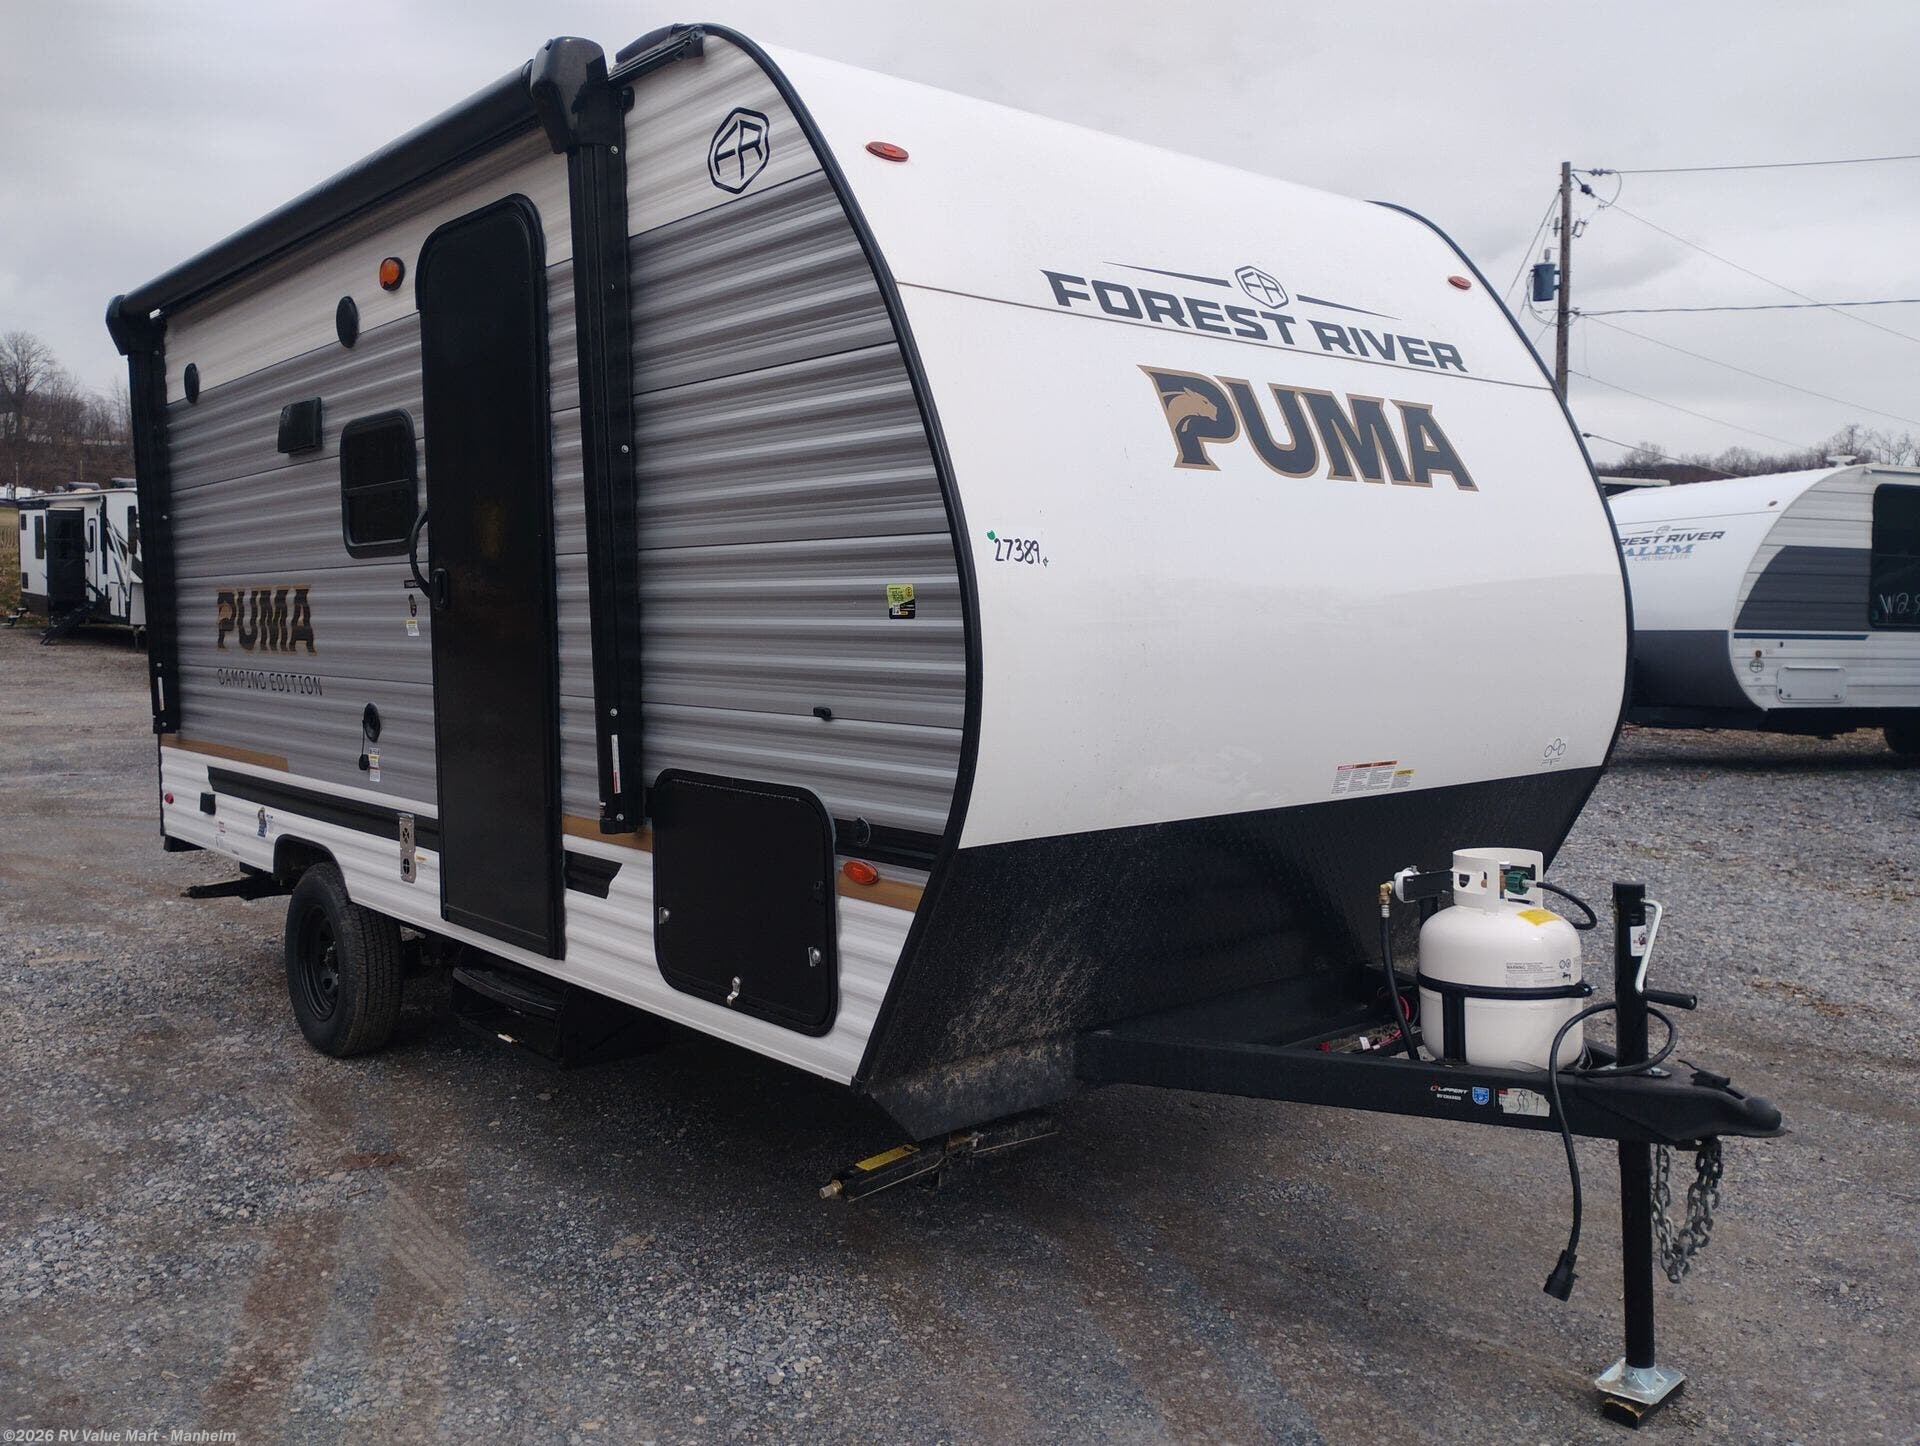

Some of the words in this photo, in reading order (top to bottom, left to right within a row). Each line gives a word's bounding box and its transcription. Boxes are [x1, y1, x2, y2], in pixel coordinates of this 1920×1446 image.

[1040, 270, 1297, 345] FOREST
[1307, 319, 1469, 373] RIVER
[1136, 364, 1479, 492] PUMA
[993, 538, 1041, 564] 27389
[1619, 535, 1664, 546] REST
[1665, 531, 1726, 543] RIVER
[1623, 544, 1696, 557] ALEM
[216, 584, 318, 656] PUMA
[217, 668, 267, 690] CAMPING
[269, 673, 323, 696] EDITION
